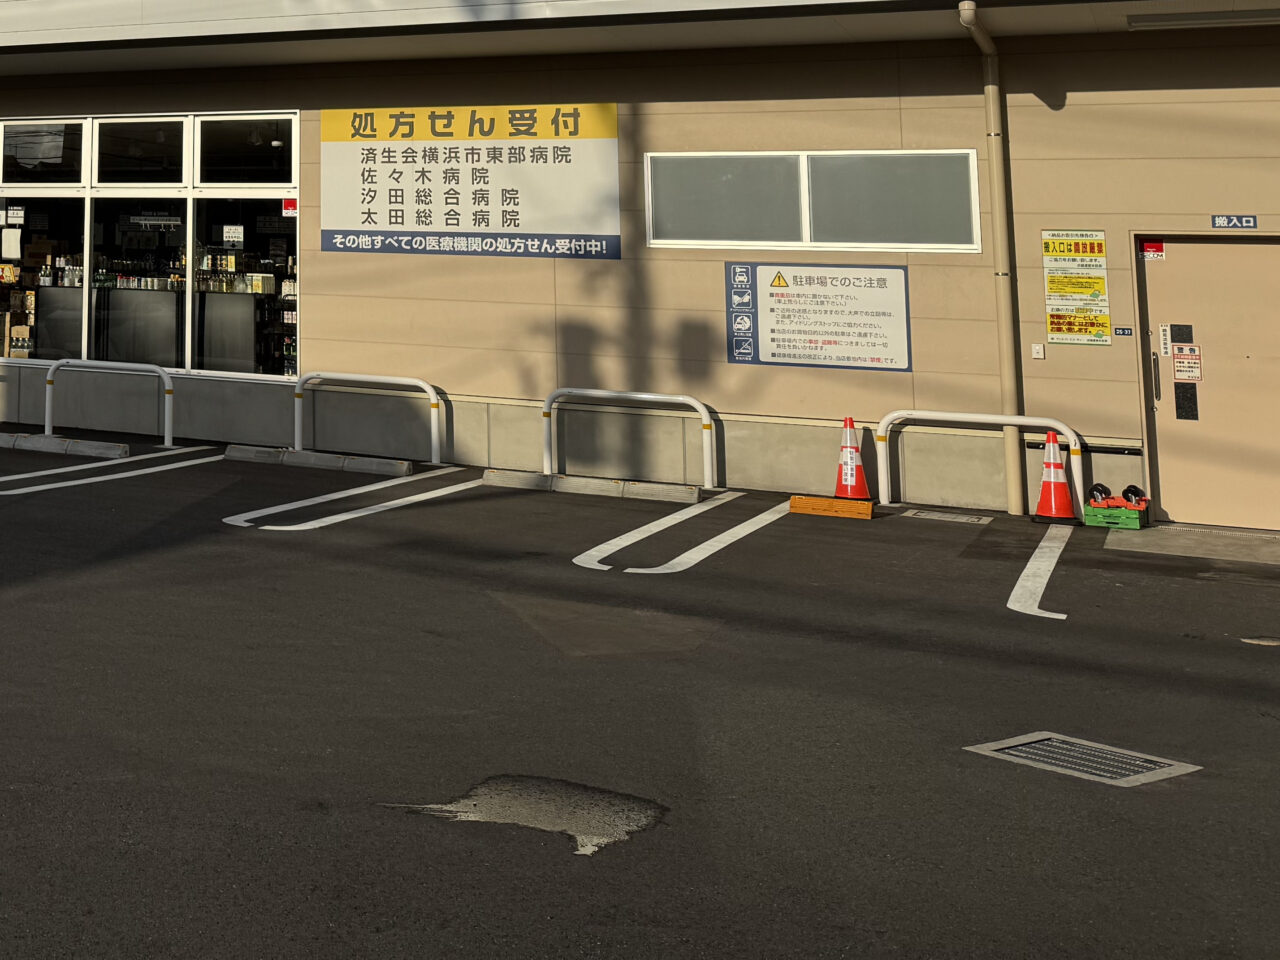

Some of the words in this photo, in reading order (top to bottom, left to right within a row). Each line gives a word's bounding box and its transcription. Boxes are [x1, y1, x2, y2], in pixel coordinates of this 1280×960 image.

[351, 107, 581, 139] 処方せん受付
[360, 146, 572, 165] 済生会横浜市東部病院
[360, 167, 490, 185] 佐々木病院
[360, 188, 520, 207] 汐田総合病院
[360, 208, 521, 228] 太田総合病院
[1214, 216, 1254, 227] 搬入口
[792, 275, 888, 289] 駐車場でのご注意
